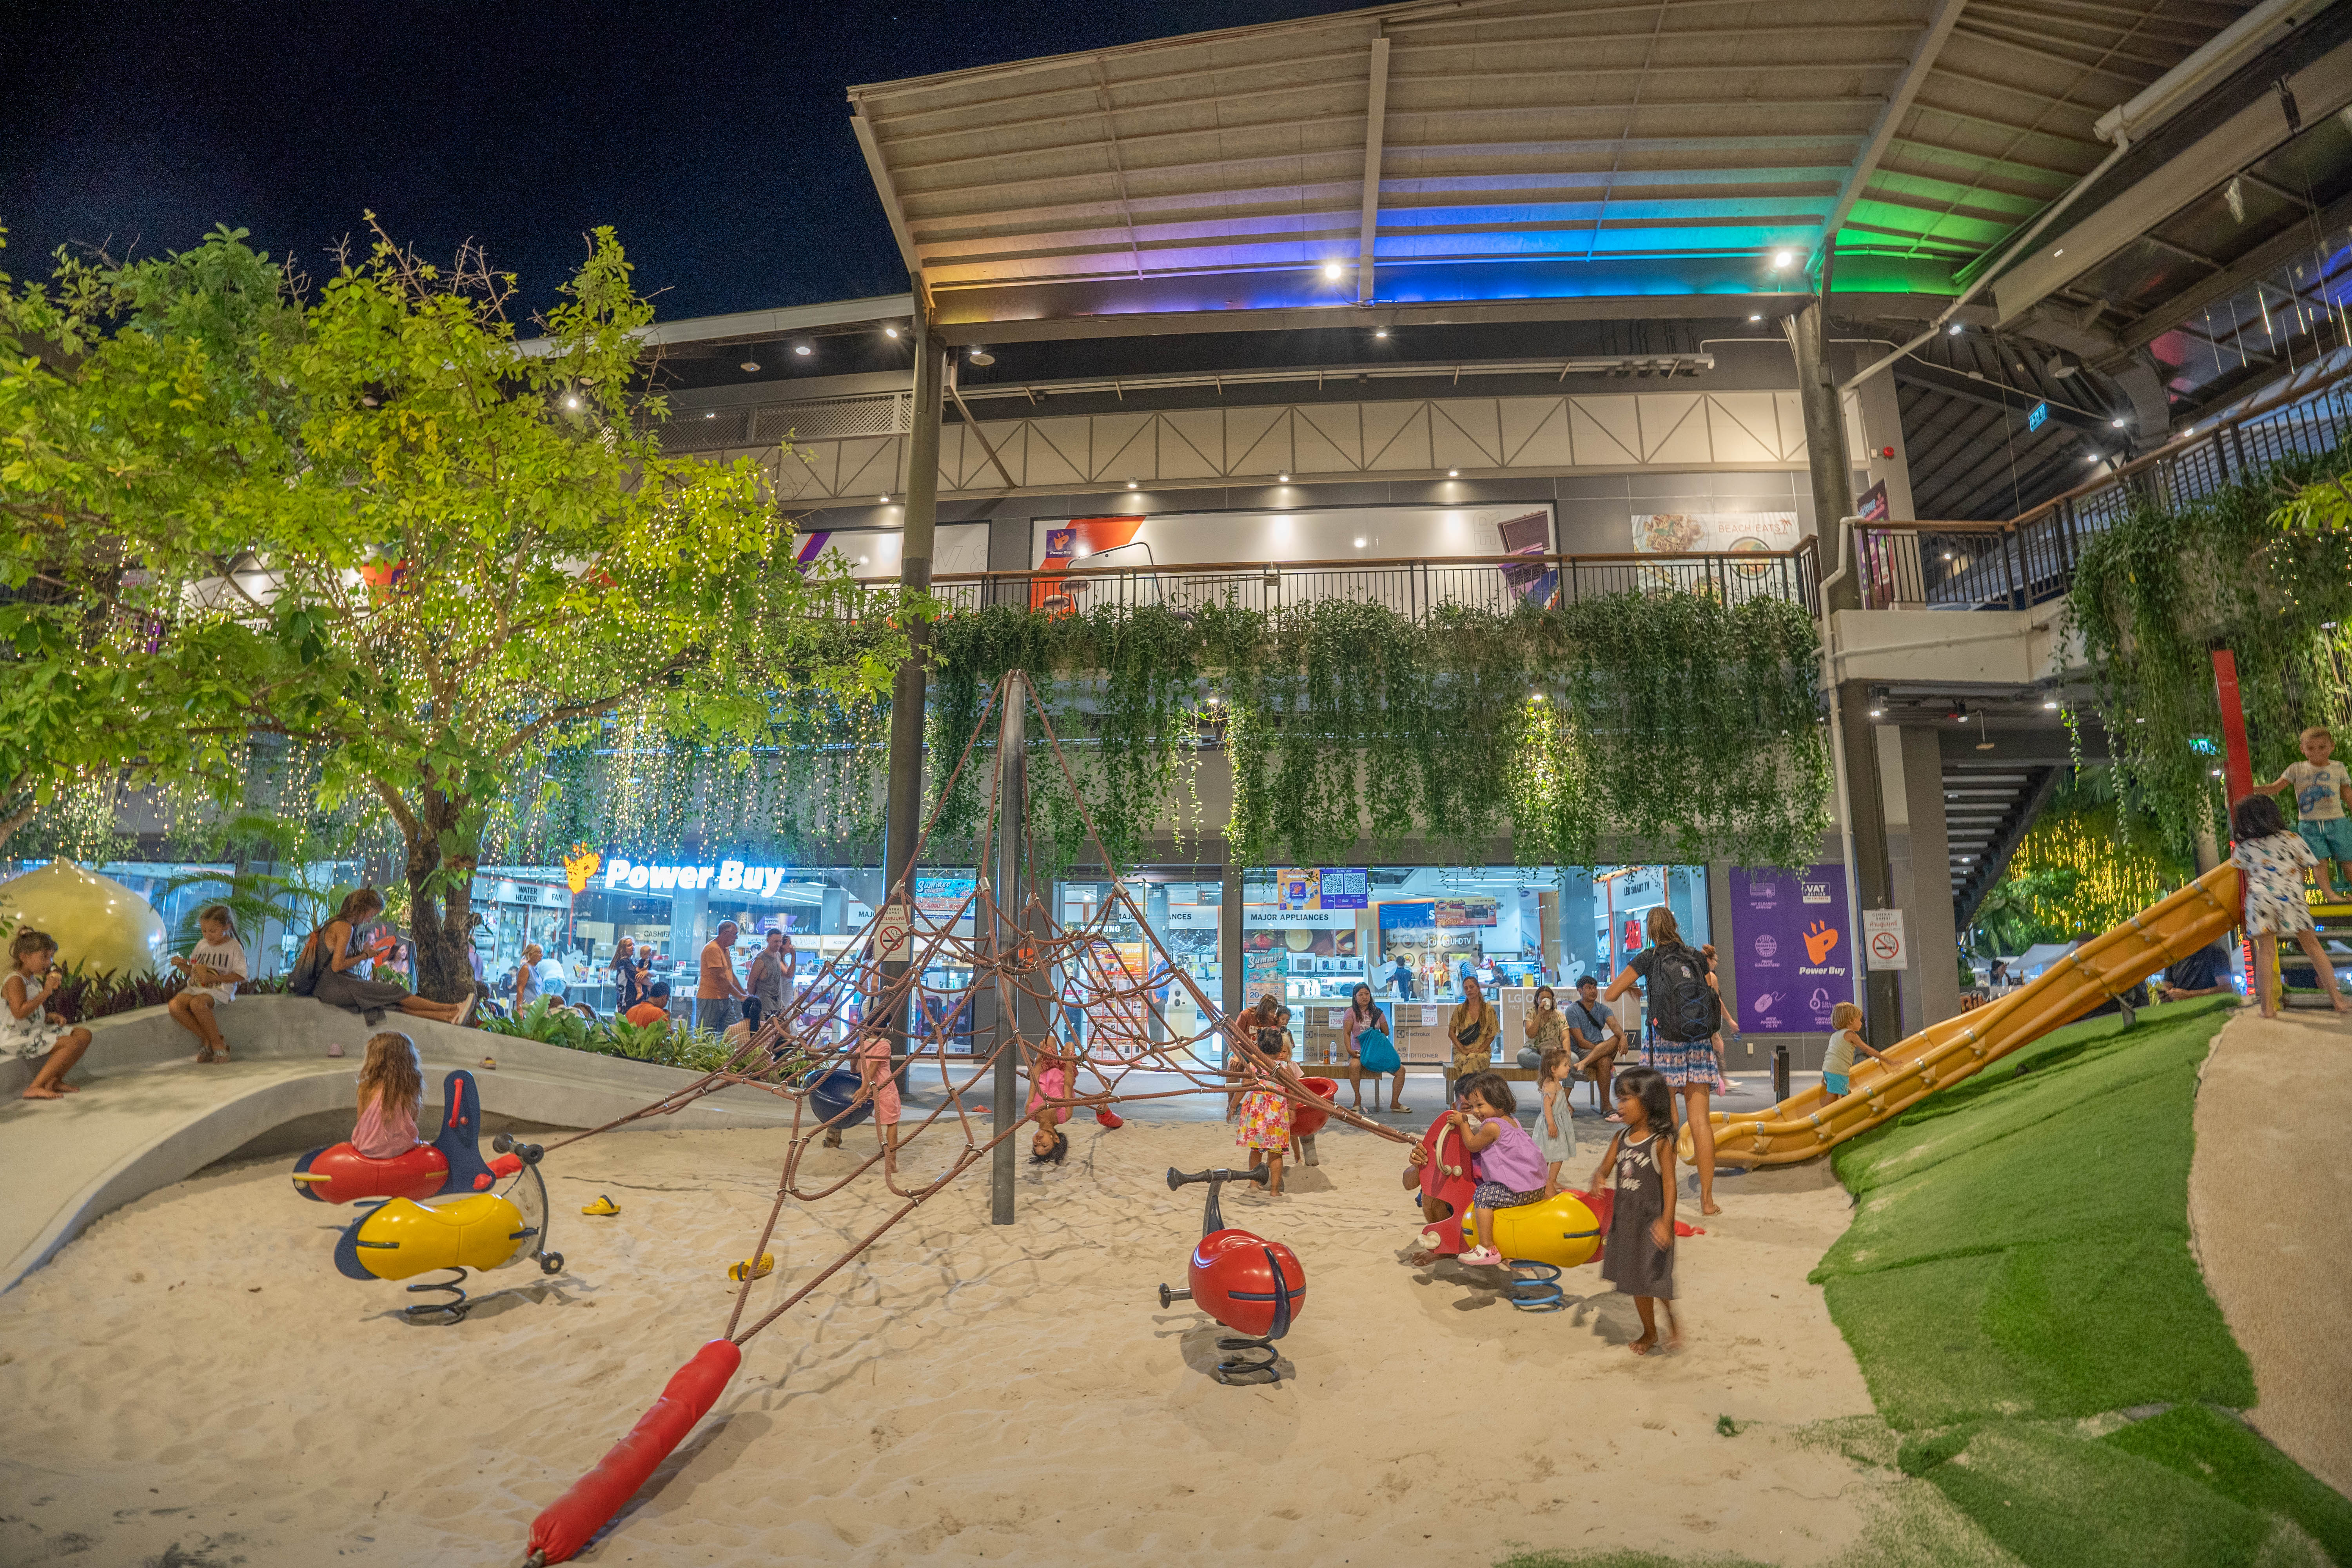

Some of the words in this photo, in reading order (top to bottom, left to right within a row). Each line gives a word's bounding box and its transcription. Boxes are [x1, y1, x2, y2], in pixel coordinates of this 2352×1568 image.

[1718, 523, 1751, 533] BEACH
[1755, 523, 1780, 532] EATS
[604, 858, 715, 889] Power
[718, 860, 785, 898] Buy
[518, 885, 538, 895] WATER
[916, 880, 951, 893] Summer
[1631, 883, 1643, 894] SMART
[1644, 881, 1650, 891] TV
[515, 894, 537, 903] HEATER
[552, 893, 563, 901] FAN
[781, 925, 804, 934] Dairy
[1247, 955, 1284, 969] Summer
[1799, 966, 1828, 975] Power
[1828, 966, 1846, 976] Buy
[1508, 994, 1522, 1003] LG
